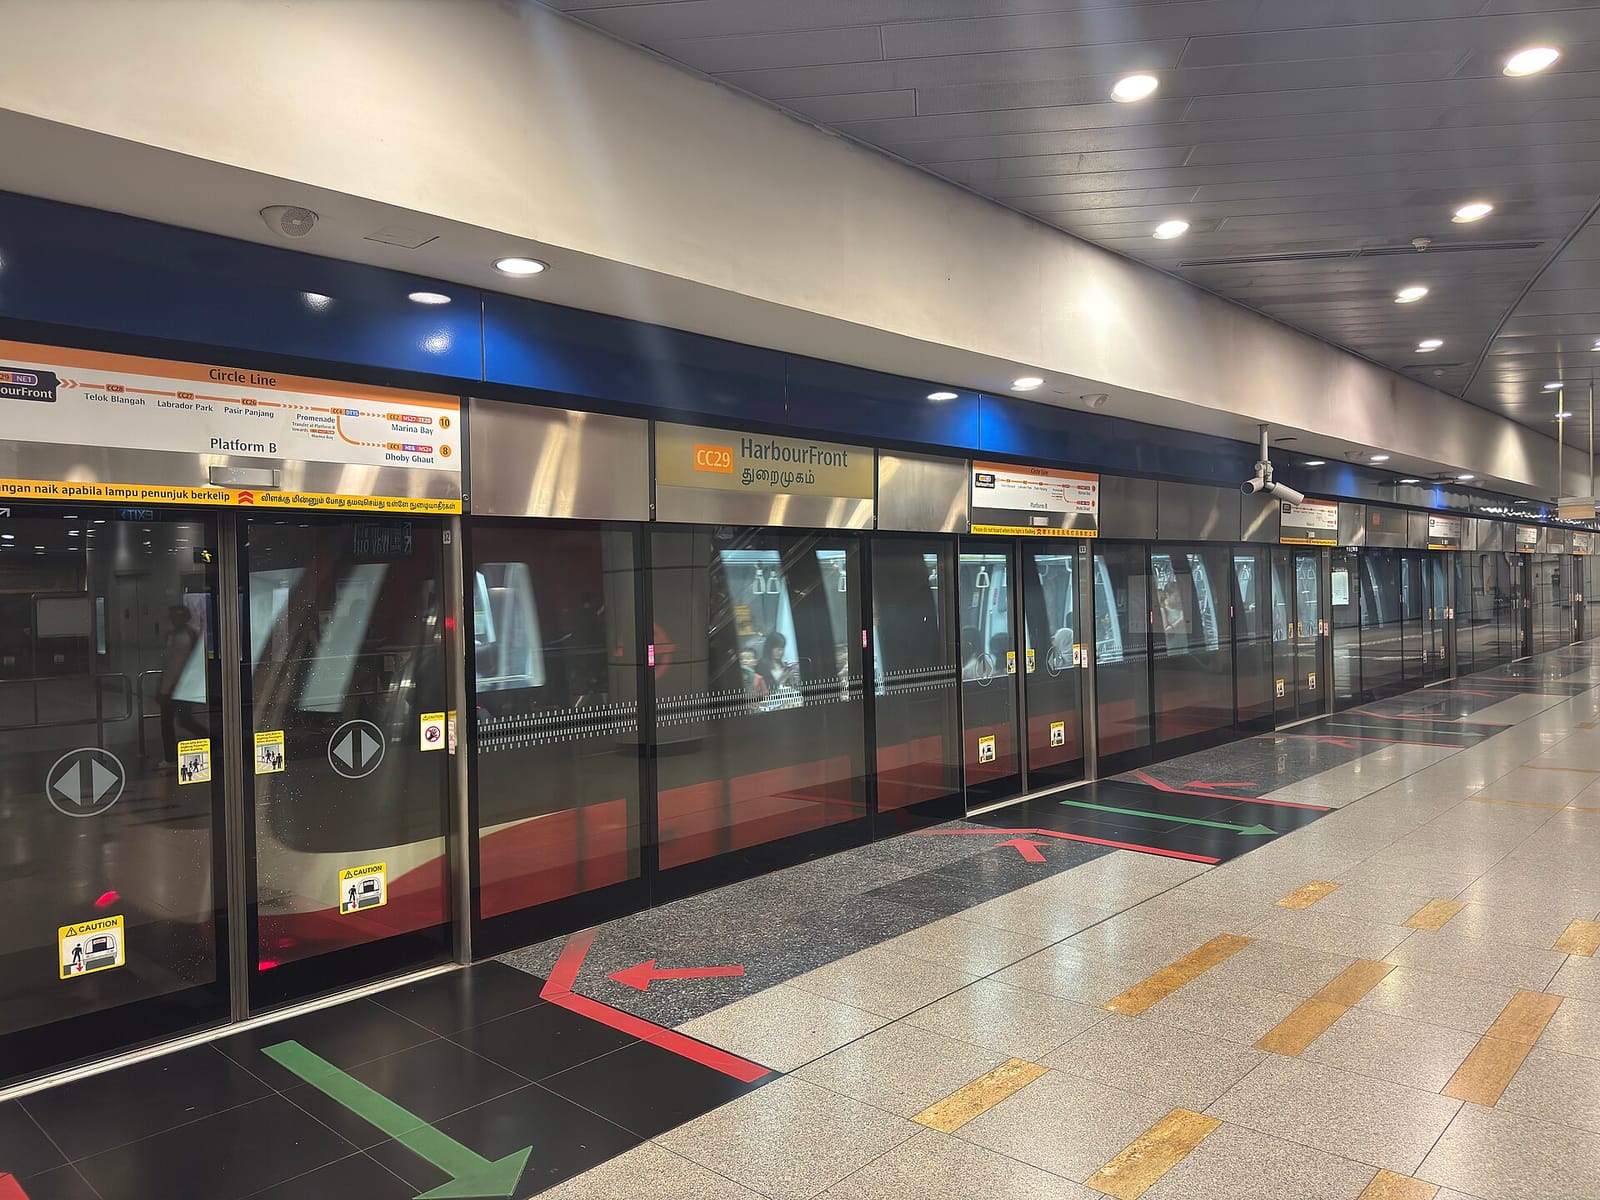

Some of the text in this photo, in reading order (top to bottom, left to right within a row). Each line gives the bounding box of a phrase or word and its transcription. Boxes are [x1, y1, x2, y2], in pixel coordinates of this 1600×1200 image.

[16, 375, 32, 383] NE1
[209, 368, 277, 387] Circle Line
[84, 392, 146, 406] Telok Blangah
[177, 392, 194, 400] CC27
[157, 400, 214, 412] Labrador Park
[224, 406, 275, 418] Pasir Panjang
[296, 413, 336, 424] Promenade
[441, 418, 450, 427] 10
[391, 423, 434, 435] Marina Bay
[210, 438, 277, 453] Platform B
[442, 446, 449, 455] 8
[740, 437, 848, 467] HarbourFront
[385, 453, 434, 464] Dhoby Ghaut
[696, 449, 731, 468] CC29
[741, 467, 815, 488] துறைமுகம்
[0, 484, 230, 502] ngan naik apabila lampu penunjuk berkelip
[353, 865, 383, 876] CAUTION
[78, 919, 118, 933] CAUTION
